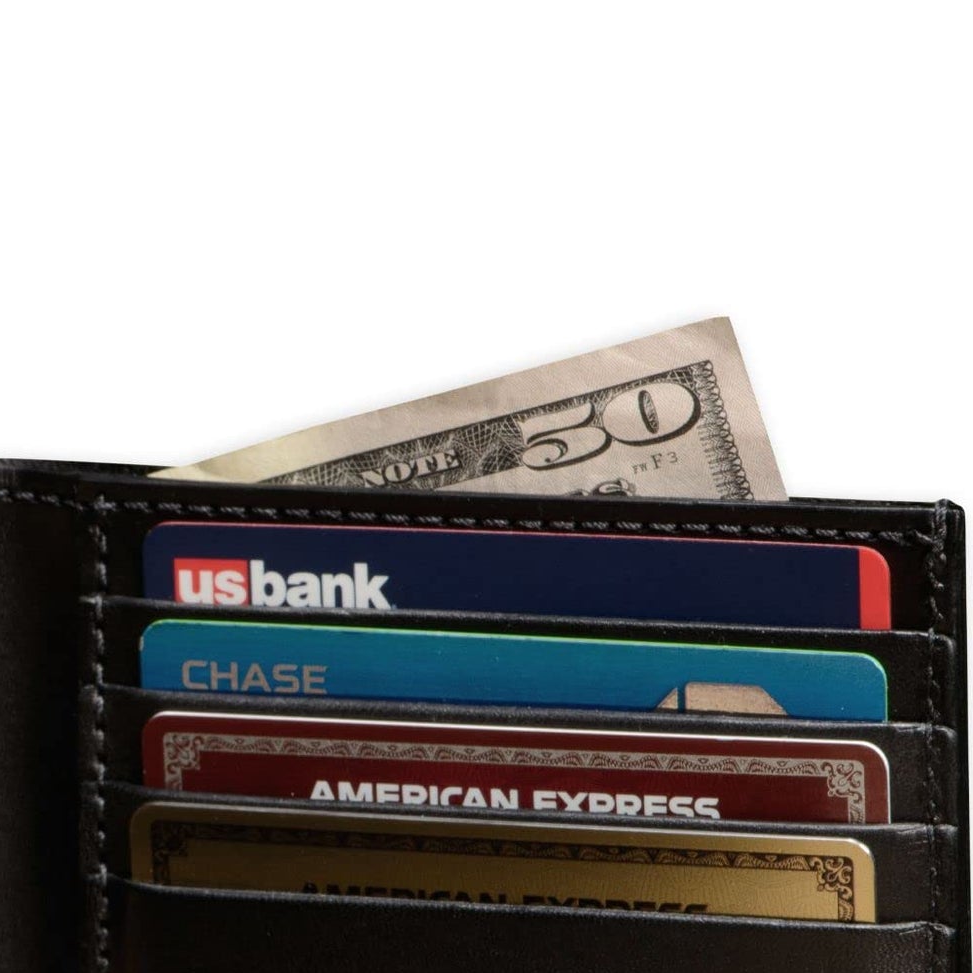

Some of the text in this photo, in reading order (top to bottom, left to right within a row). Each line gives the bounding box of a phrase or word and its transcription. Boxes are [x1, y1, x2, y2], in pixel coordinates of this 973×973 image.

[521, 381, 702, 472] 50
[360, 449, 463, 488] NOTE
[181, 659, 329, 695] CHASE
[310, 780, 721, 820] AMERICAN EXPRESS
